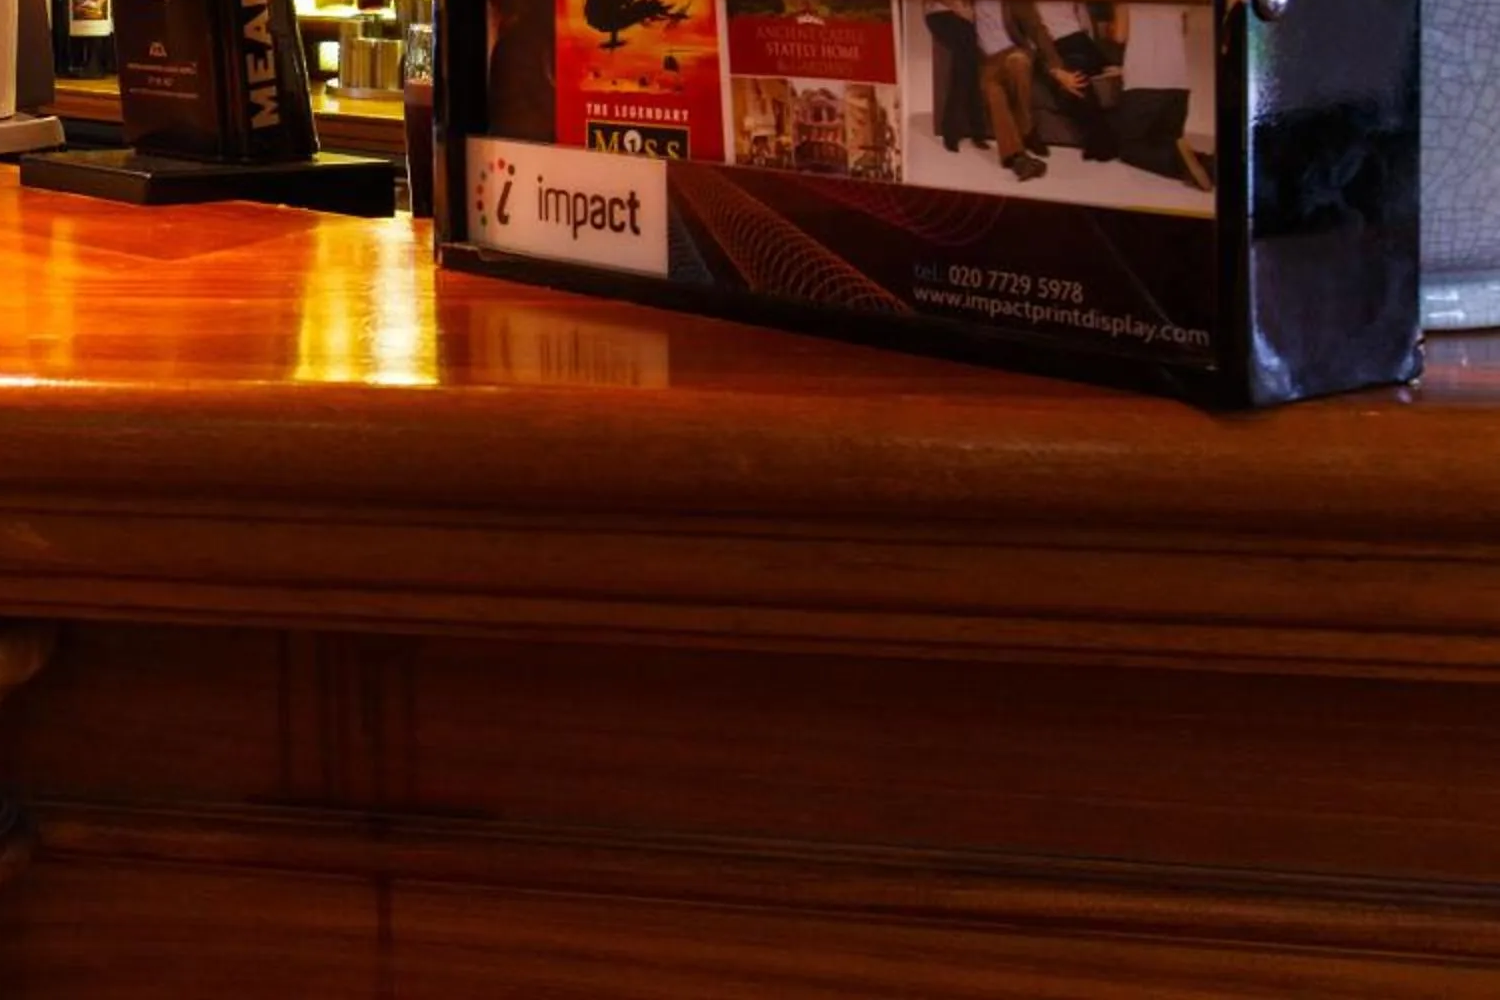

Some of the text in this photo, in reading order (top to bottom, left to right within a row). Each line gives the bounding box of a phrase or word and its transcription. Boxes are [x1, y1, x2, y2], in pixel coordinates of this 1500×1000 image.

[820, 43, 861, 59] HOME
[586, 103, 690, 122] THE LEGENDARY
[537, 175, 642, 240] impact
[948, 265, 983, 289] 020
[987, 269, 1032, 295] 7729
[1037, 278, 1085, 305] 5978
[913, 285, 1211, 348] www.impactprintdisplay.com
